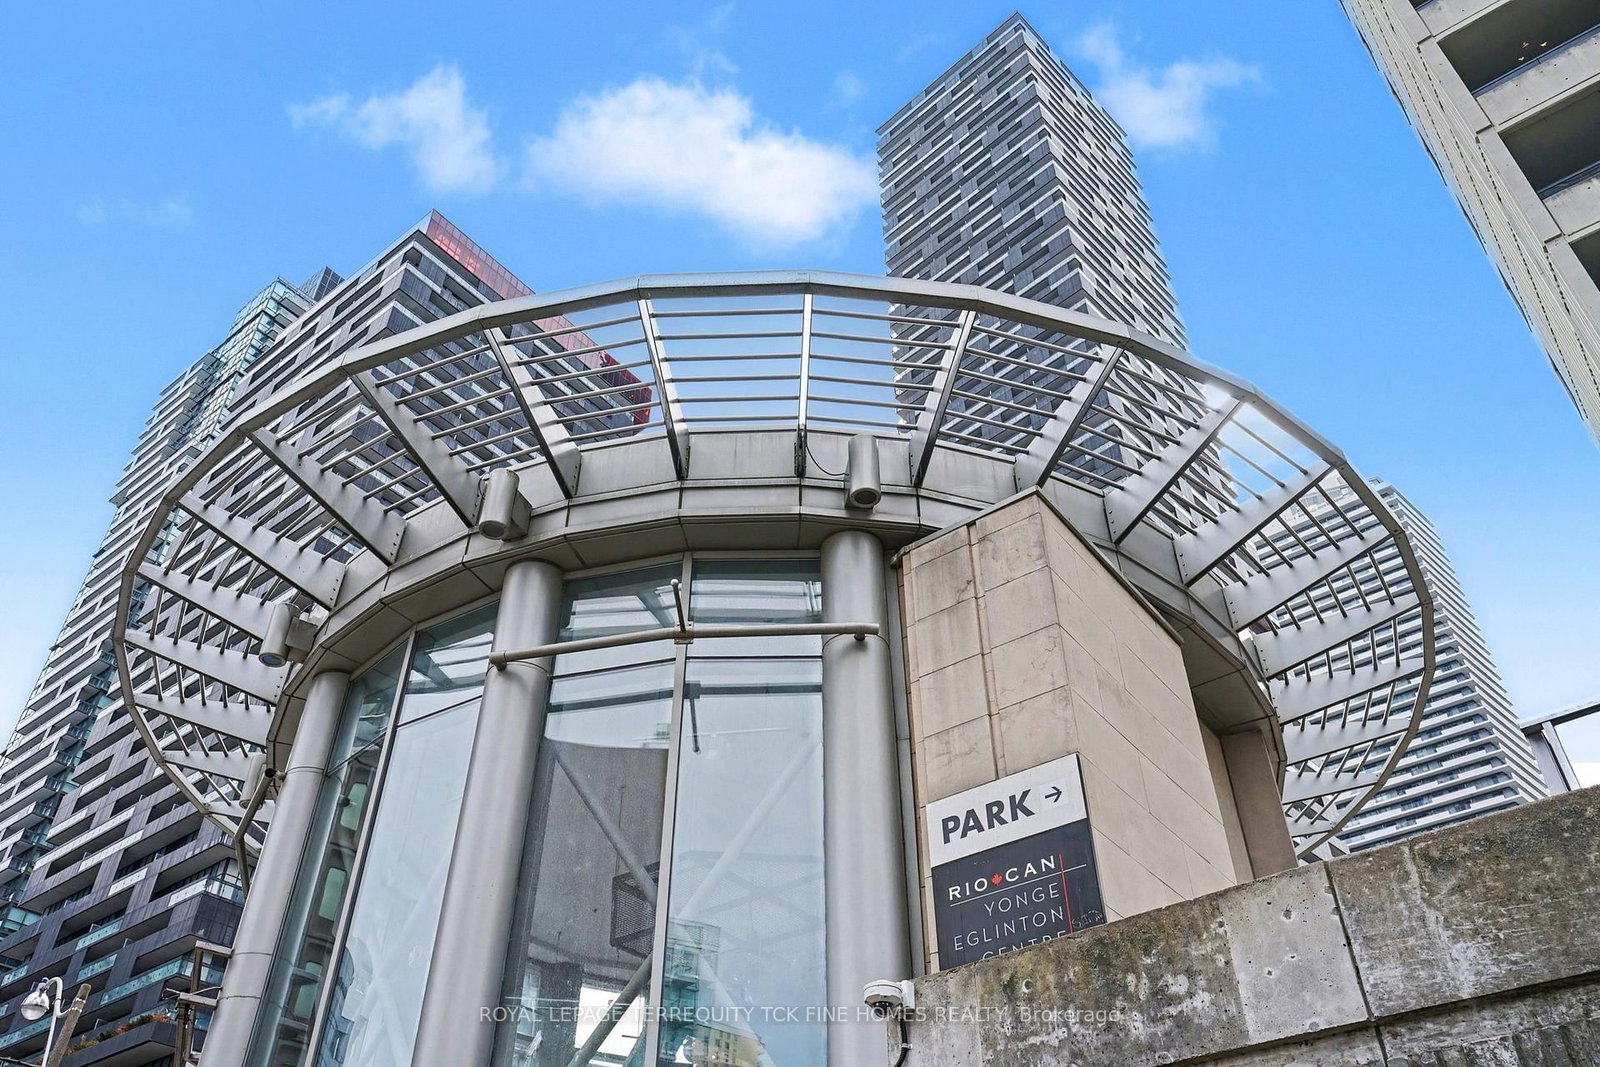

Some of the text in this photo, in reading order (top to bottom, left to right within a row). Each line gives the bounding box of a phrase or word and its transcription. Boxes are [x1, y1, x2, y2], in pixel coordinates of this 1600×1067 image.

[941, 788, 1036, 845] PARK
[948, 855, 1056, 901] RIO CAN
[984, 882, 1060, 917] YONGE
[953, 906, 1064, 951] EGLINTON
